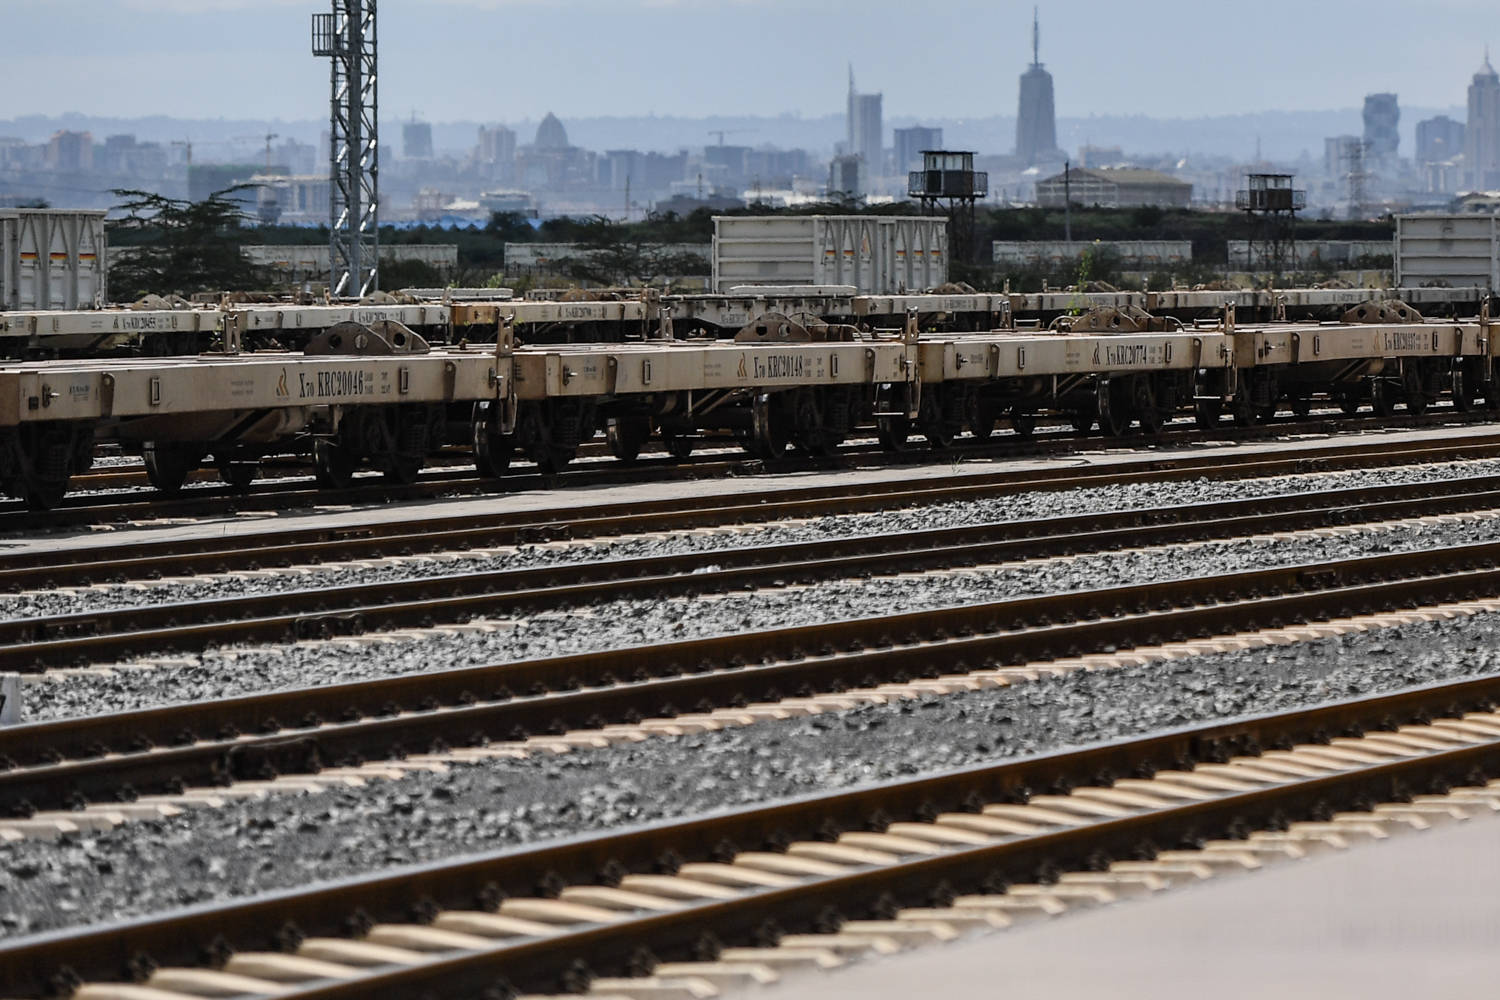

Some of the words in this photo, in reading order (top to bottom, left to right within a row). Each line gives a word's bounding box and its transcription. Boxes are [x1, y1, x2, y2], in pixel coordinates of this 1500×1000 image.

[753, 356, 766, 379] X70
[767, 355, 803, 378] KRC20148
[1116, 344, 1147, 366] KRC20774
[299, 372, 315, 398] X70
[318, 370, 363, 397] KRC20046
